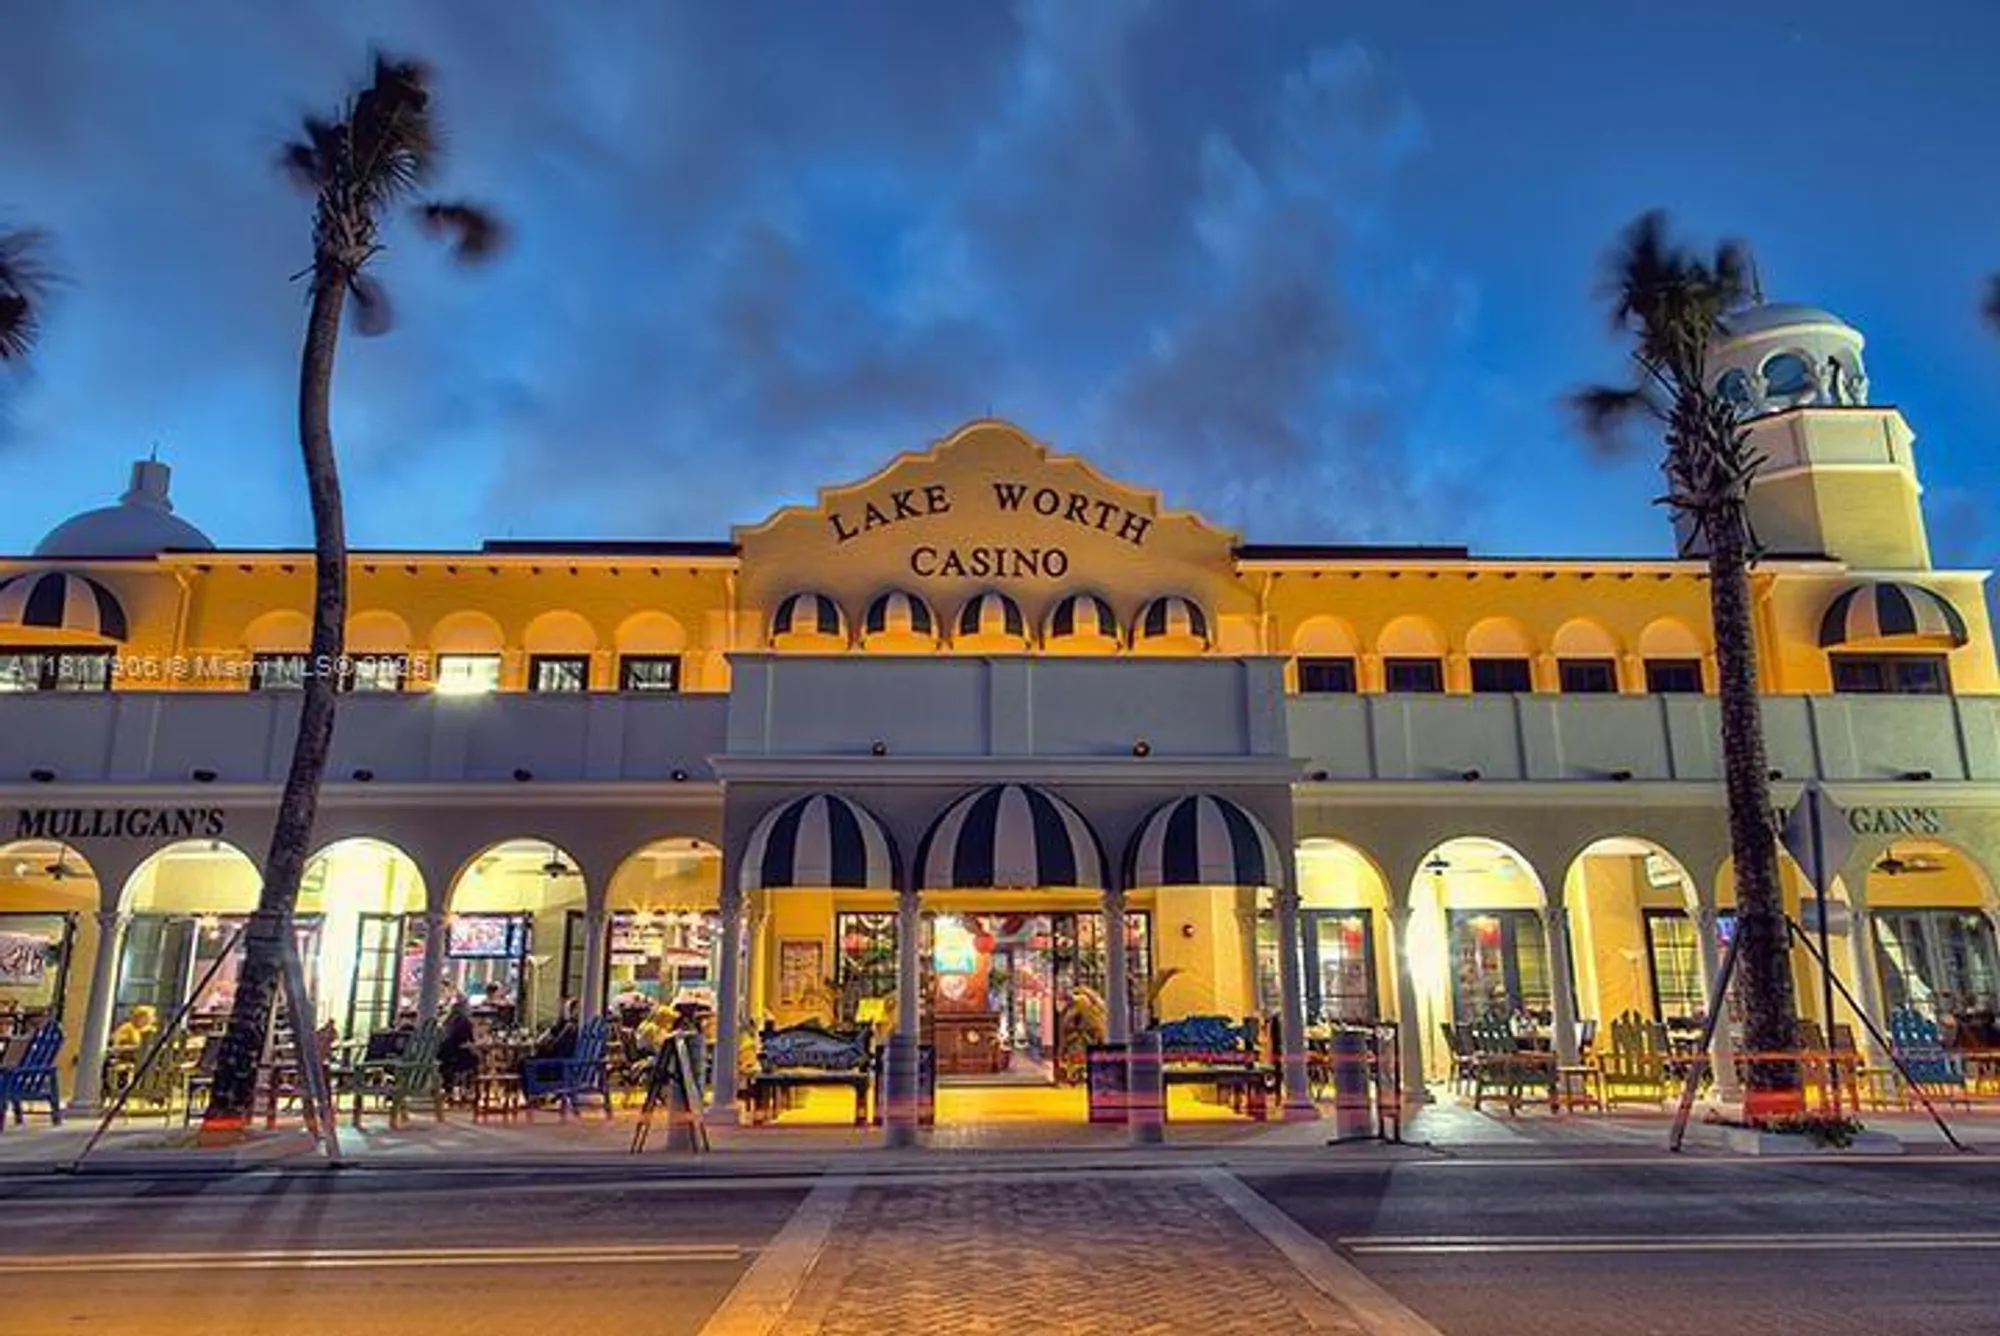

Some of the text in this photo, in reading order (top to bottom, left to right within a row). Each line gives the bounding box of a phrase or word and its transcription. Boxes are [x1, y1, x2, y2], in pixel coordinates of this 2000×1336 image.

[828, 483, 1153, 546] LAKE WORTH
[910, 546, 1069, 577] CASINO
[16, 808, 225, 839] MULLIGAN'S
